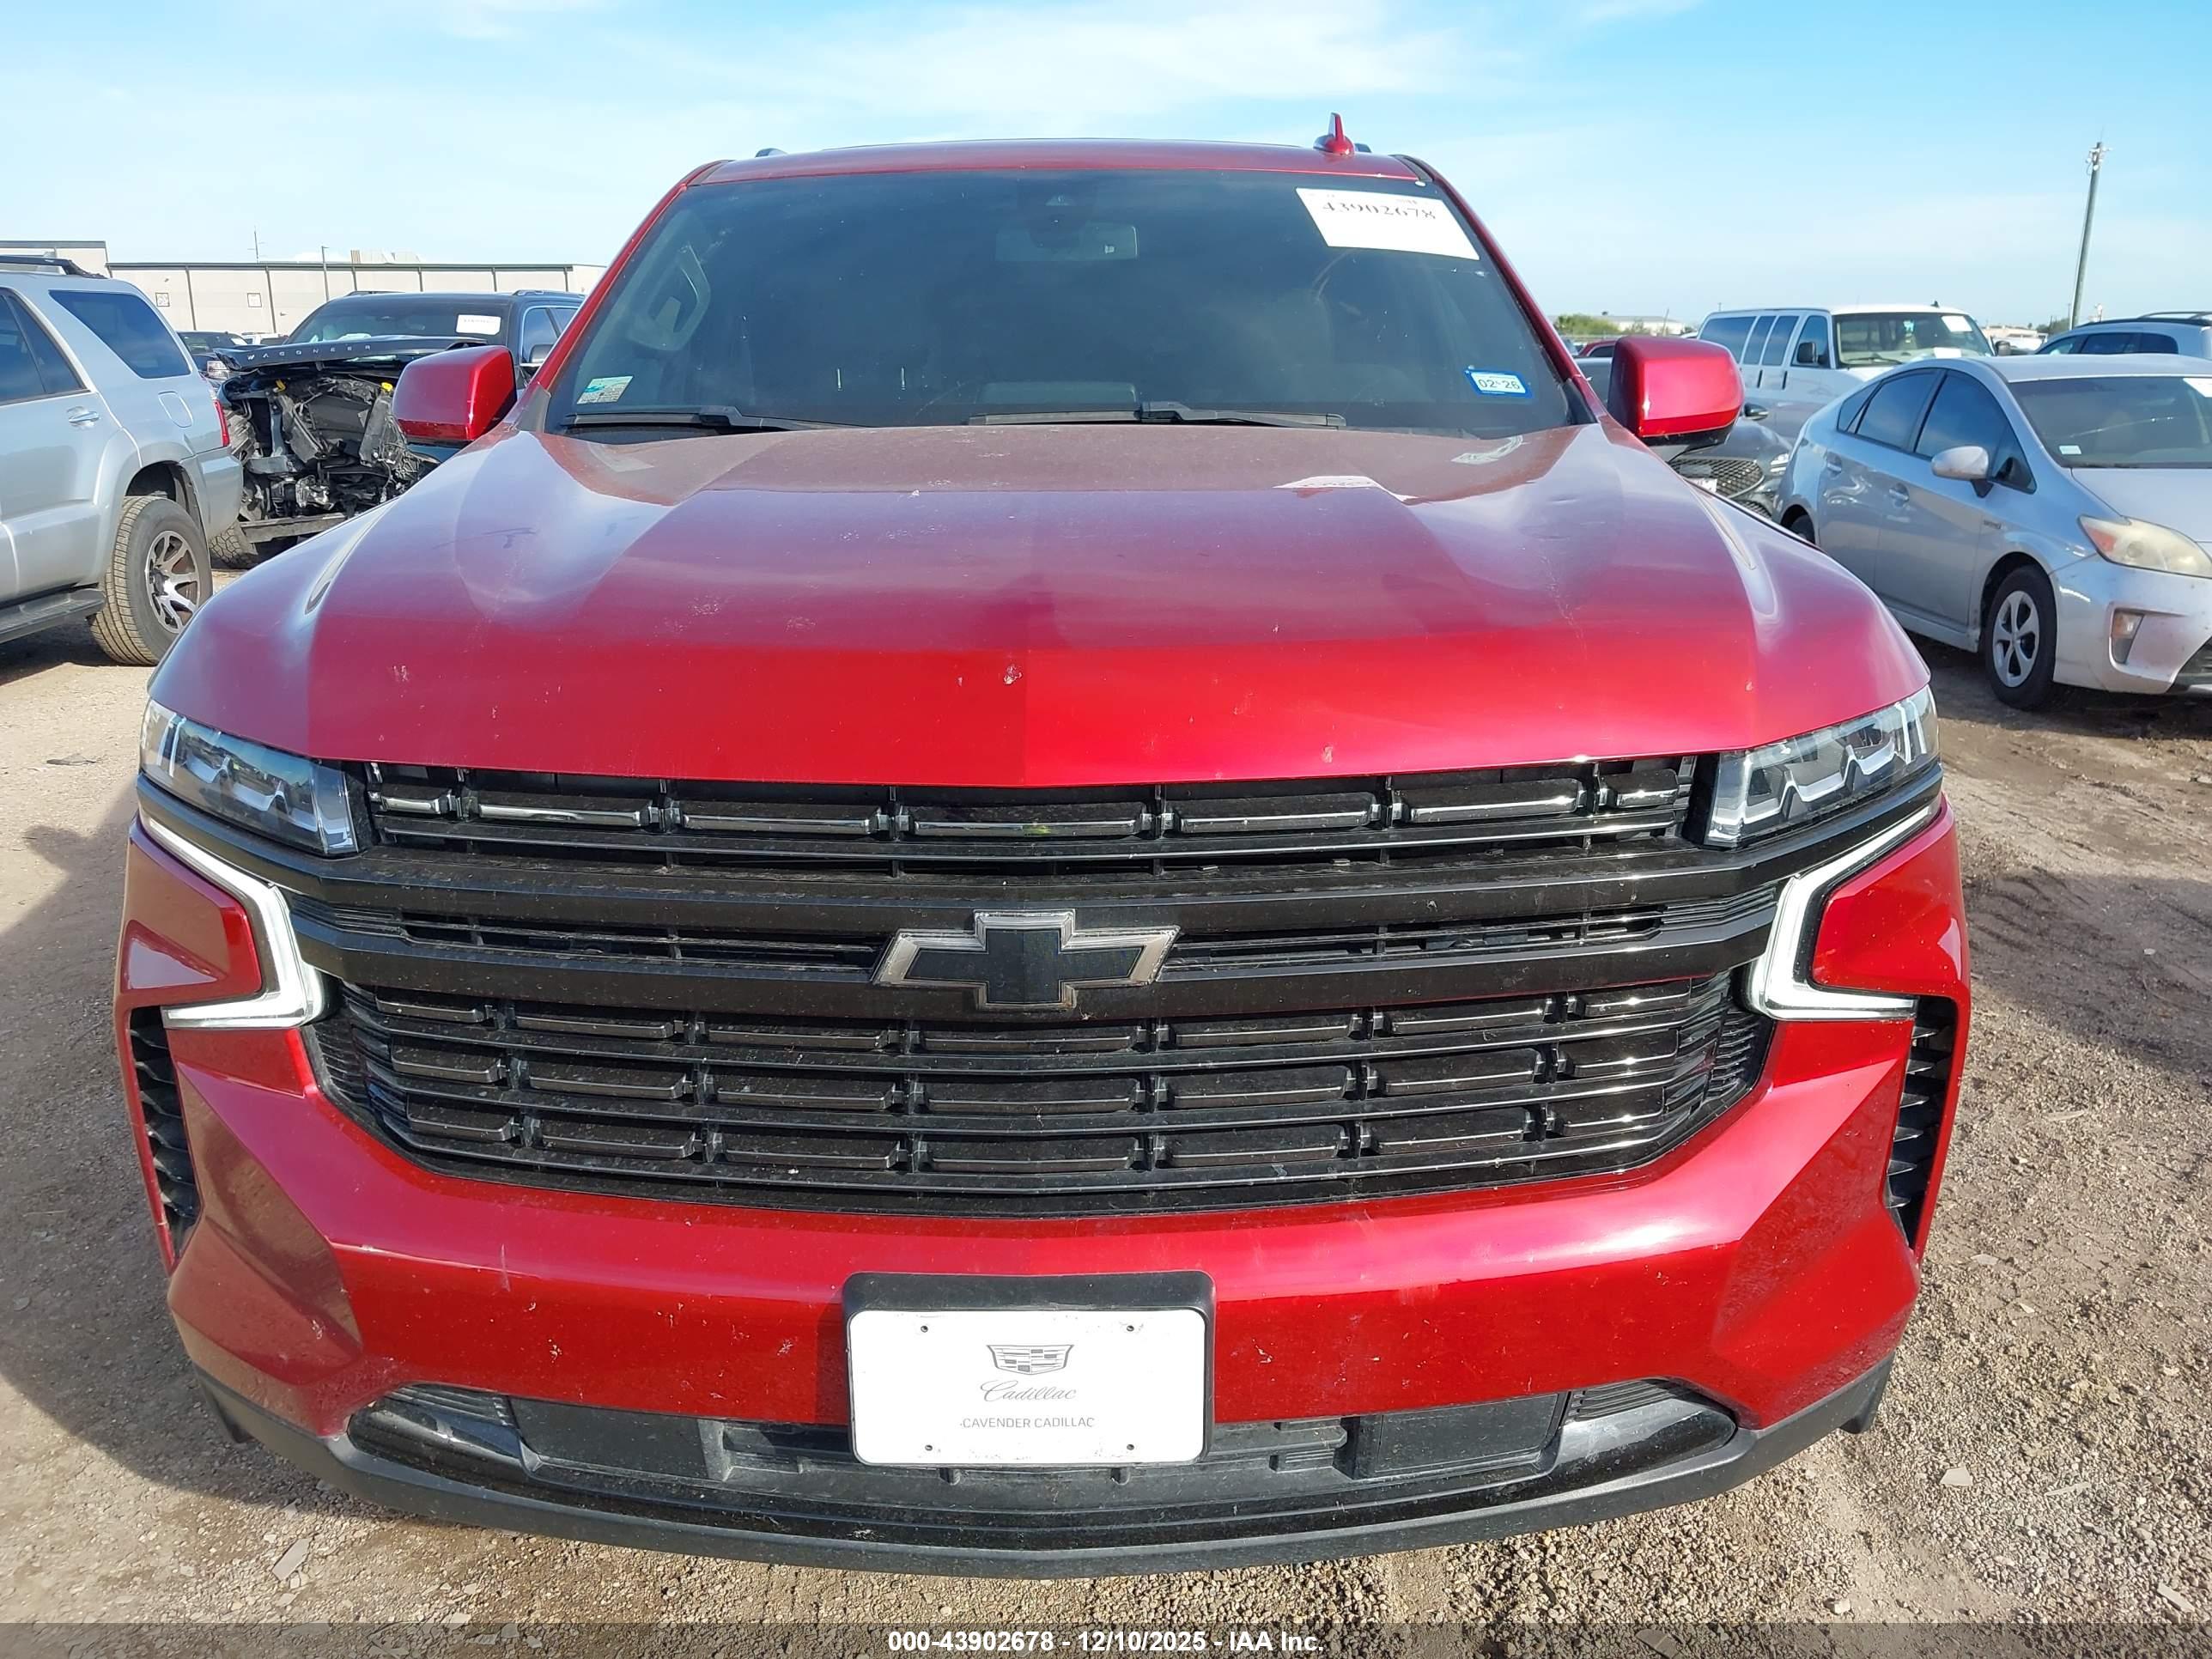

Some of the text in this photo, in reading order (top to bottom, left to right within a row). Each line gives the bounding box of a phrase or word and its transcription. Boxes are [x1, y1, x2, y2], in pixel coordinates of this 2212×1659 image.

[246, 344, 371, 361] WAGONEER
[980, 1379, 1077, 1402] Cadillac
[963, 1417, 1095, 1428] CAVENDER CADILLAC
